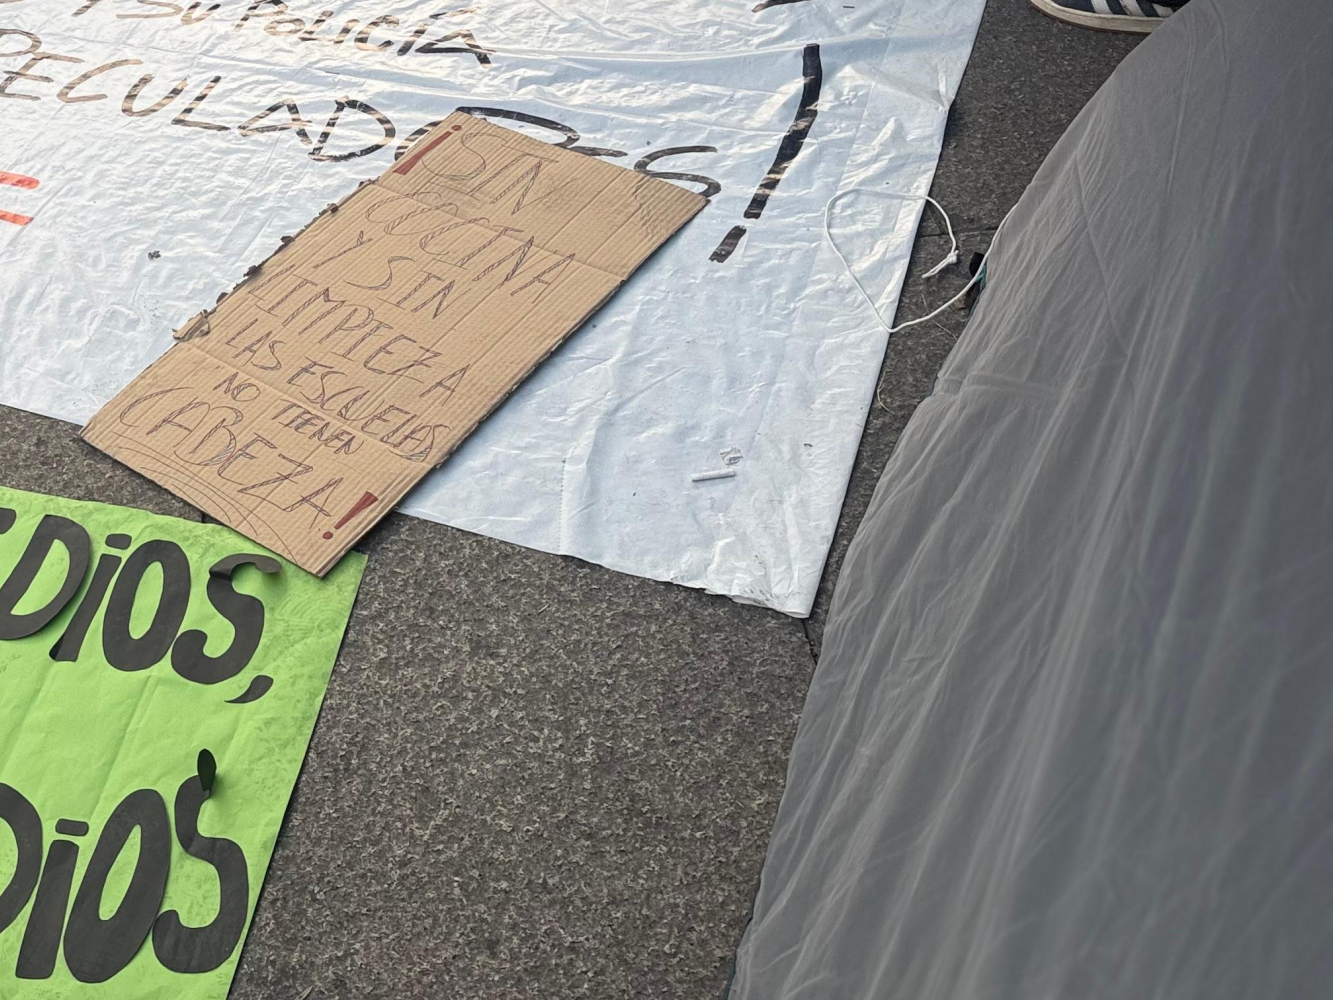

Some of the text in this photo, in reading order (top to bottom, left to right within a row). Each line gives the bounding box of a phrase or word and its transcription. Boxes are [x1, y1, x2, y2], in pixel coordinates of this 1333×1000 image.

[313, 230, 472, 319] Y SIN
[365, 191, 576, 304] COCINA
[225, 318, 452, 462] LAS ESCUELAS
[248, 264, 471, 406] LIMPIEZA
[212, 371, 365, 455] NO TIENEN
